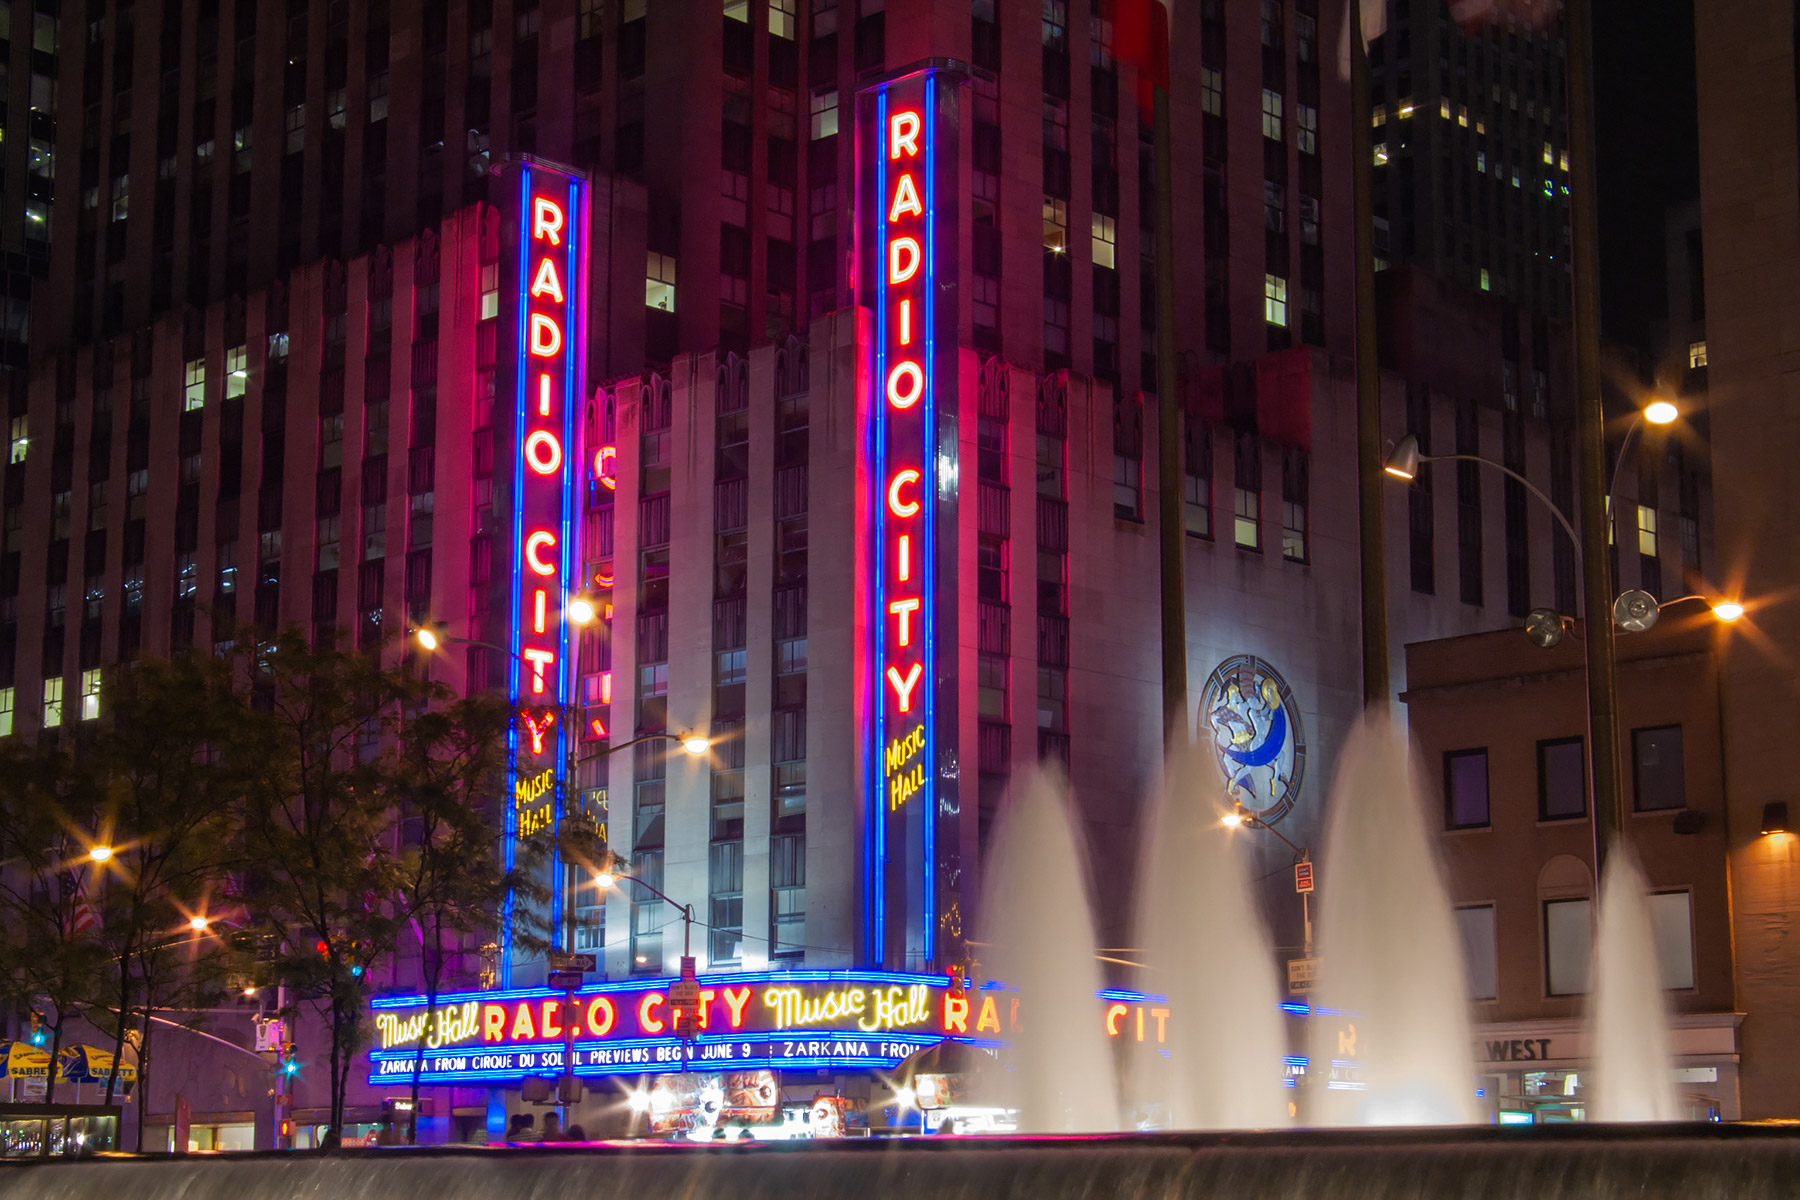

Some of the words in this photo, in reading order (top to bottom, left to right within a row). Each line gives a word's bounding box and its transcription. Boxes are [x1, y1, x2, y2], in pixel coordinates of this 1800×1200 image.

[887, 111, 923, 409] RADIO
[525, 197, 563, 474] RADIO
[886, 469, 922, 712] CITY
[521, 531, 556, 754] CITY
[886, 724, 925, 777] MUSIC
[515, 769, 553, 810] MUSIC
[891, 764, 925, 811] HALL
[427, 1001, 480, 1049] Hall
[764, 987, 865, 1029] Music
[859, 985, 929, 1031] Hall
[1106, 1004, 1170, 1043] CIT
[380, 1059, 428, 1074] ZARKAA
[435, 1057, 466, 1071] FROM
[472, 1055, 513, 1069] CIRQUE
[519, 1053, 535, 1067] DU
[541, 1052, 583, 1067] SOLIL
[590, 1047, 649, 1064] PREVIEWS
[656, 1046, 694, 1062] BEGN
[701, 1043, 733, 1060] JUNE
[742, 1043, 751, 1058] 9
[783, 1042, 869, 1057] ZARKANA
[1485, 1038, 1551, 1060] WEST
